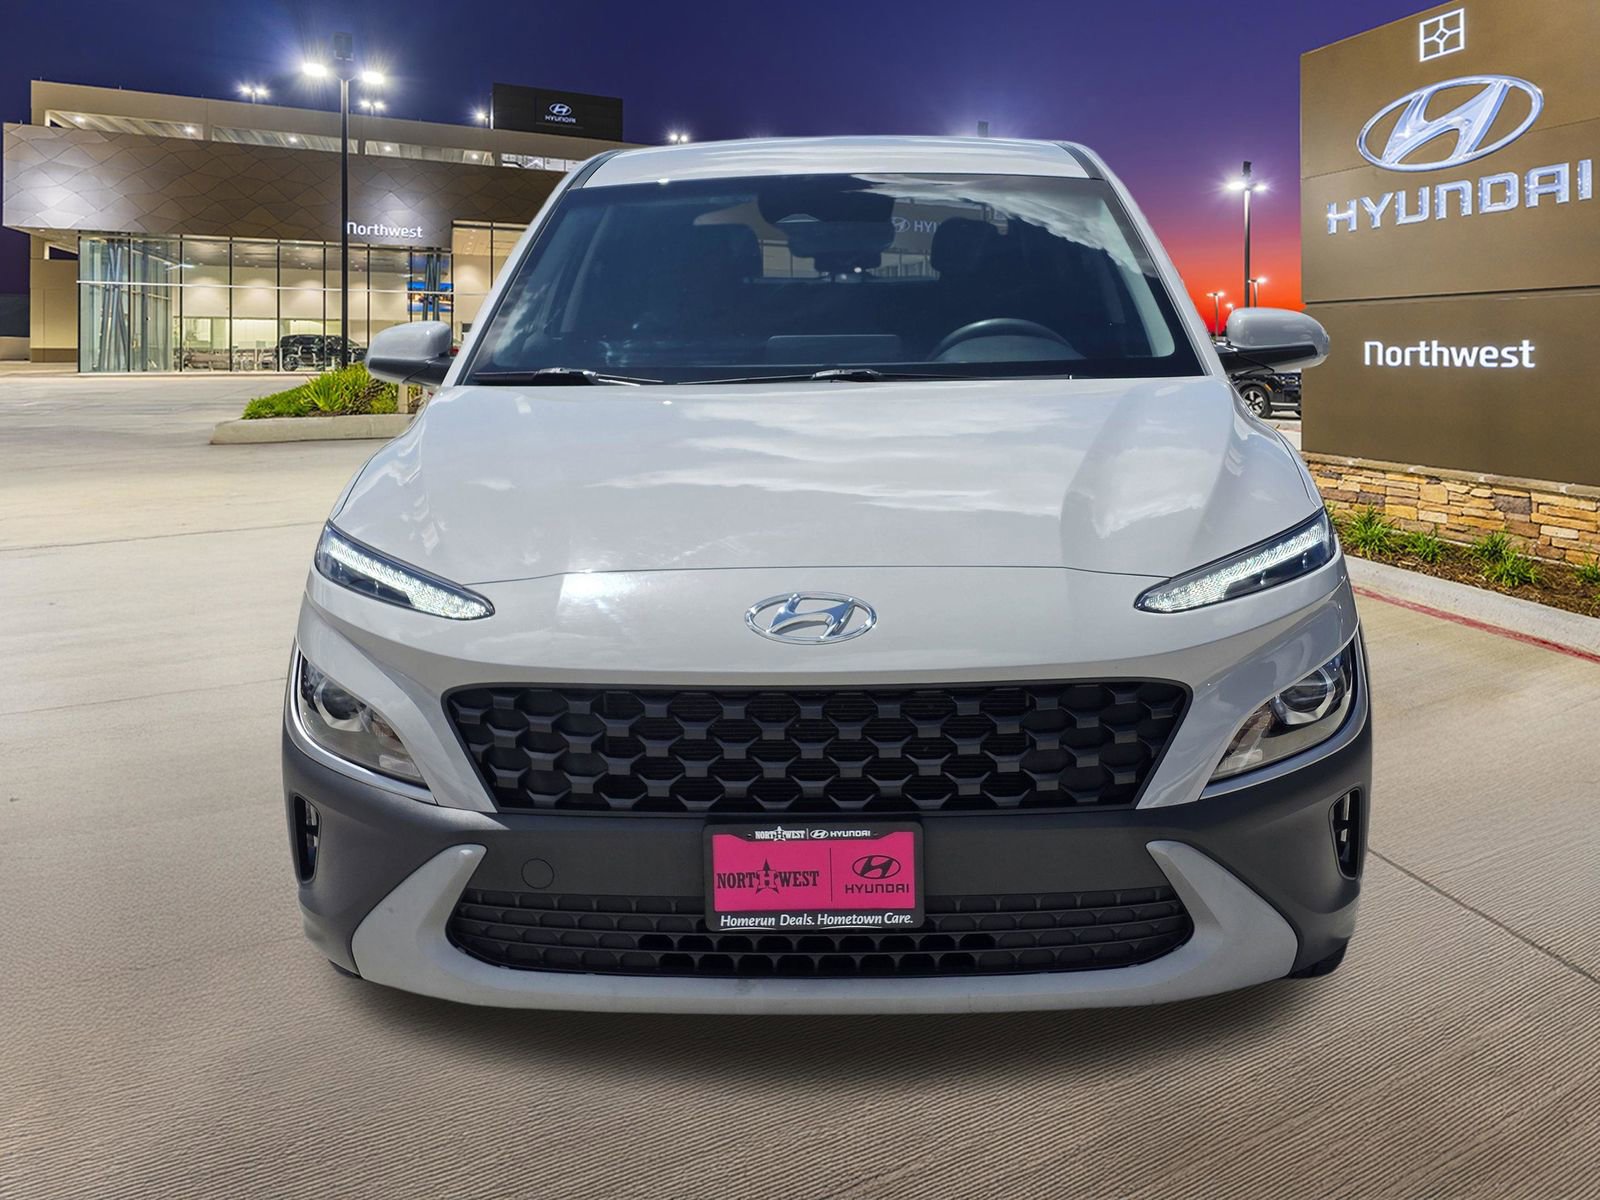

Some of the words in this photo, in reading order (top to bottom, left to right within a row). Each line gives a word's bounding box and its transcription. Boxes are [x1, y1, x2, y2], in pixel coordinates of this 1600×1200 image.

[545, 114, 576, 123] HYUNDAI
[1327, 159, 1593, 235] HYUNDAI
[346, 221, 424, 238] Northwest
[1363, 339, 1536, 369] Northwest
[830, 829, 871, 838] HYUNDAI
[716, 862, 820, 892] NORTHWEST
[845, 883, 910, 894] HYUNDAI
[720, 914, 776, 927] Homerun
[779, 913, 815, 927] Deals.
[817, 912, 882, 926] Hometown
[884, 911, 914, 925] Care.
